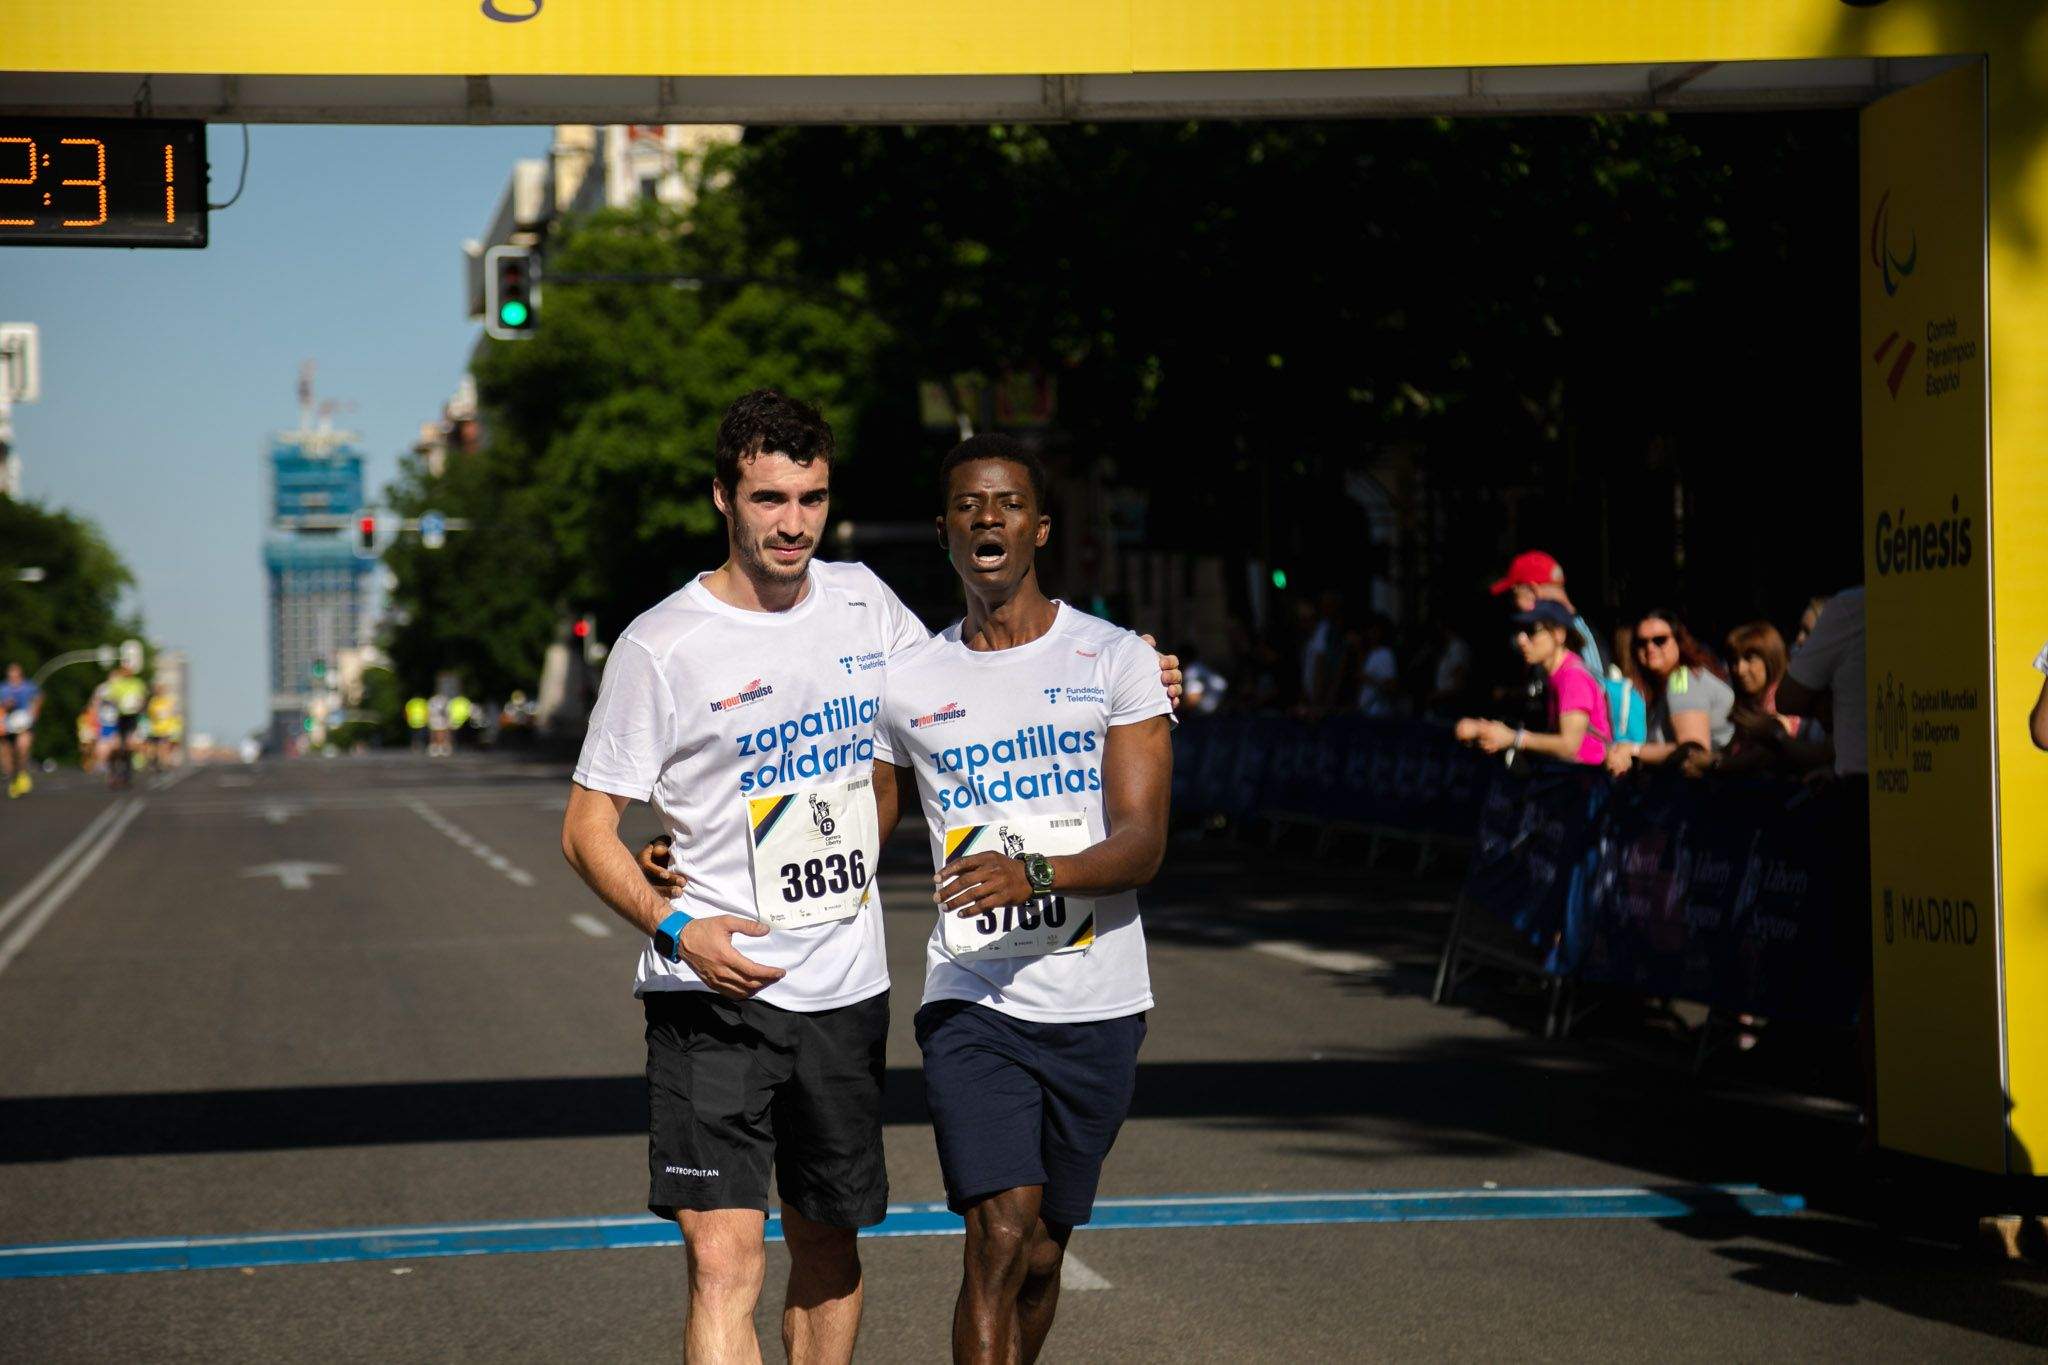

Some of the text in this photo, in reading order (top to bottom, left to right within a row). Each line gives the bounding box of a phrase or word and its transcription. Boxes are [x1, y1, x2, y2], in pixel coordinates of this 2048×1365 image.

[1926, 368, 1960, 398] Español
[1875, 494, 1973, 576] Génesis
[1912, 688, 1978, 714] Capital Mundial
[736, 694, 881, 758] zapatillas
[929, 723, 1096, 776] zapatillas
[1912, 720, 1960, 746] del Deporte
[938, 763, 1102, 812] solidarias
[822, 821, 833, 833] 13
[780, 848, 867, 904] 3836
[1901, 897, 1979, 946] MADRID
[665, 1165, 720, 1177] METROPOLITAN
